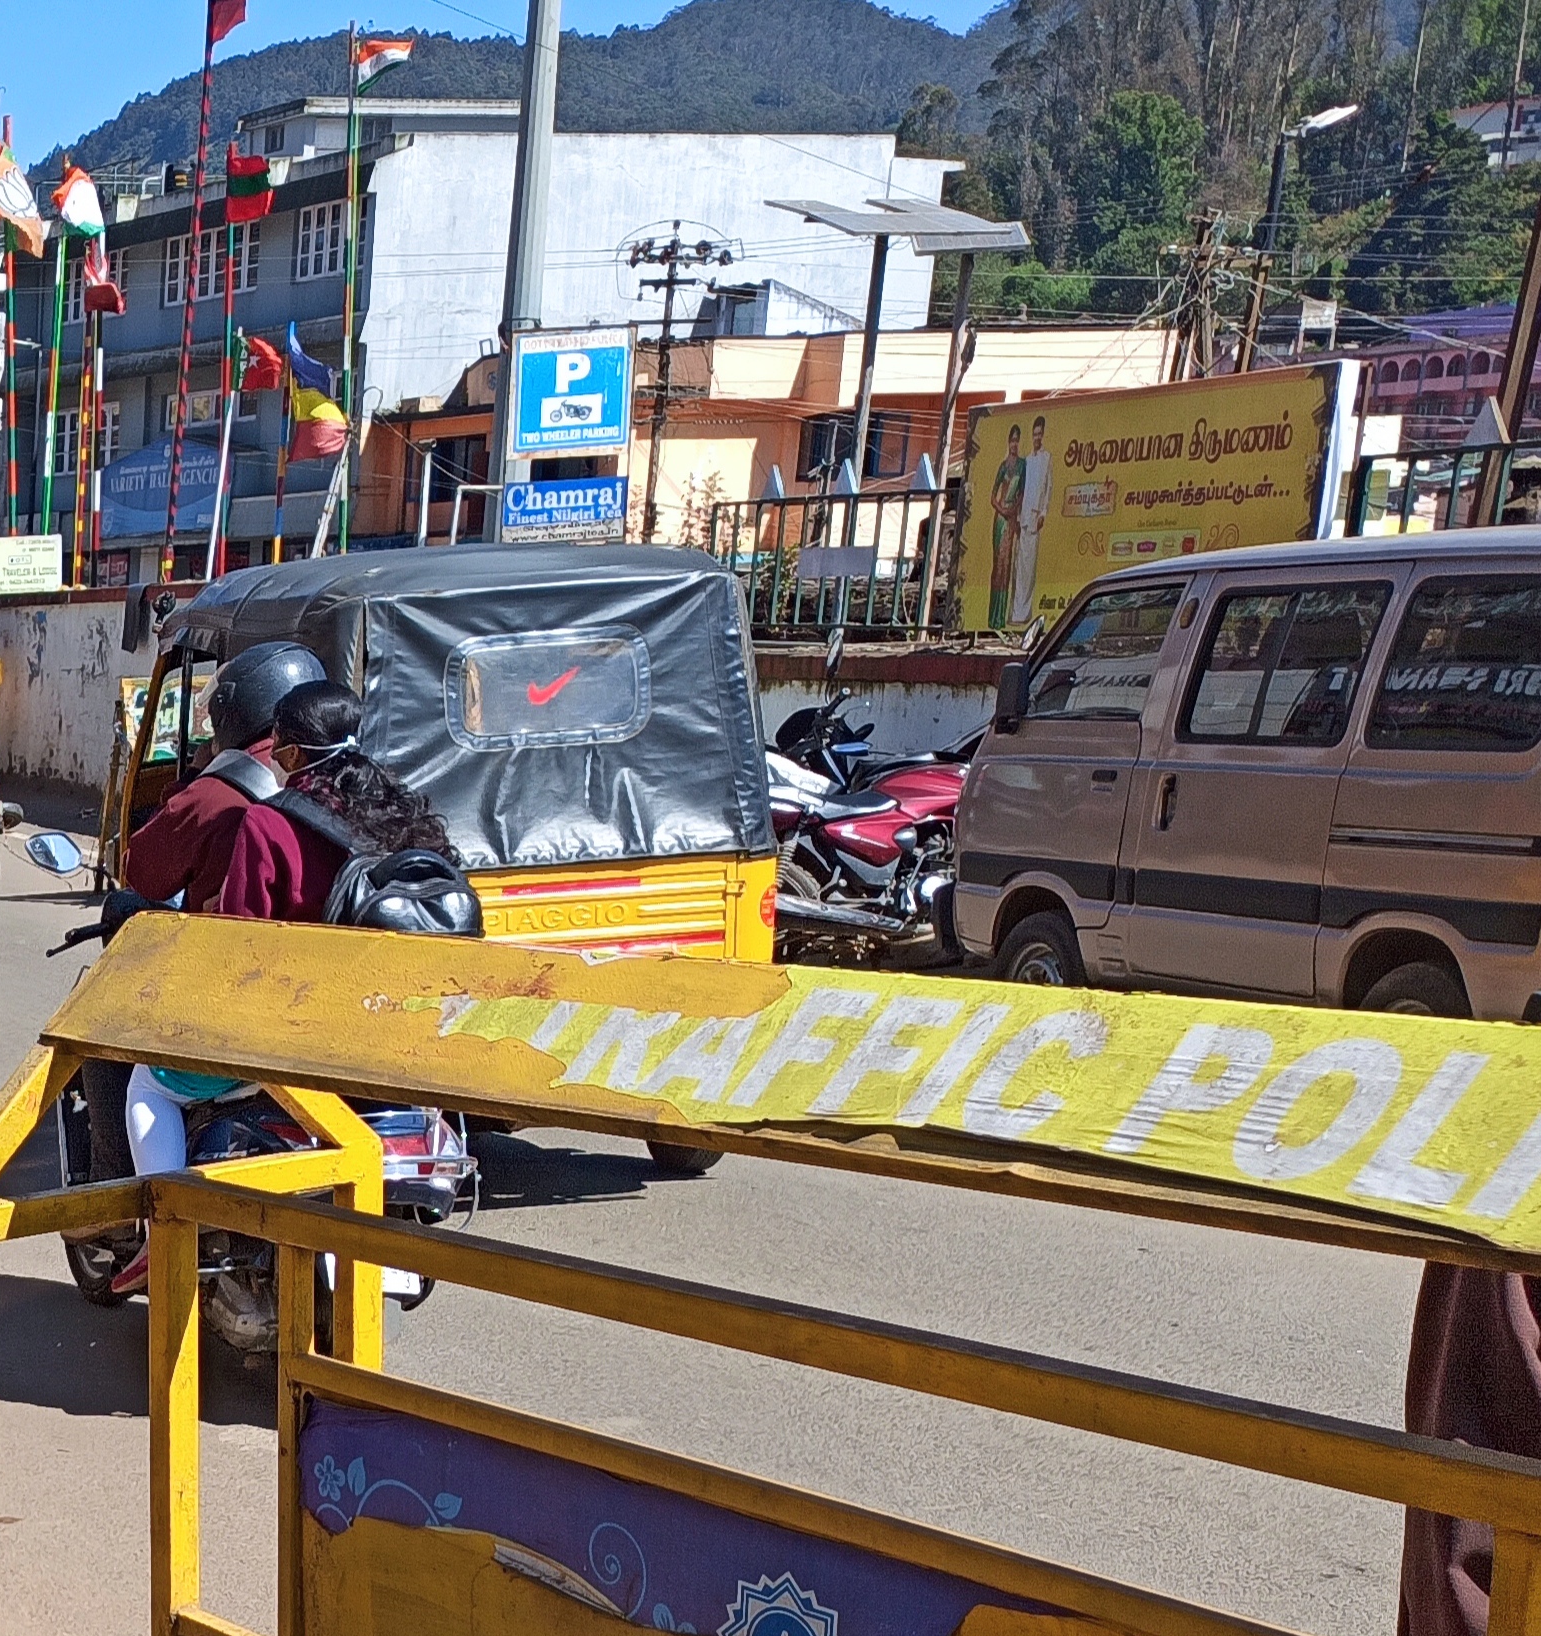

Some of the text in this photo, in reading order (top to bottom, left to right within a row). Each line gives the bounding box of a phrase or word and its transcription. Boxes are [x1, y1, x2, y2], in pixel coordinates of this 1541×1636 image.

[555, 352, 592, 394] P
[521, 426, 619, 444] TWO WHEELER PARKING
[1063, 409, 1293, 474] அருமையான திருமணம்
[110, 466, 219, 493] VARIETY HAL AGENCIE
[506, 482, 623, 512] Chamraj
[508, 506, 622, 525] Finest Nilgiri Tea
[485, 902, 631, 934] PIAGGIO
